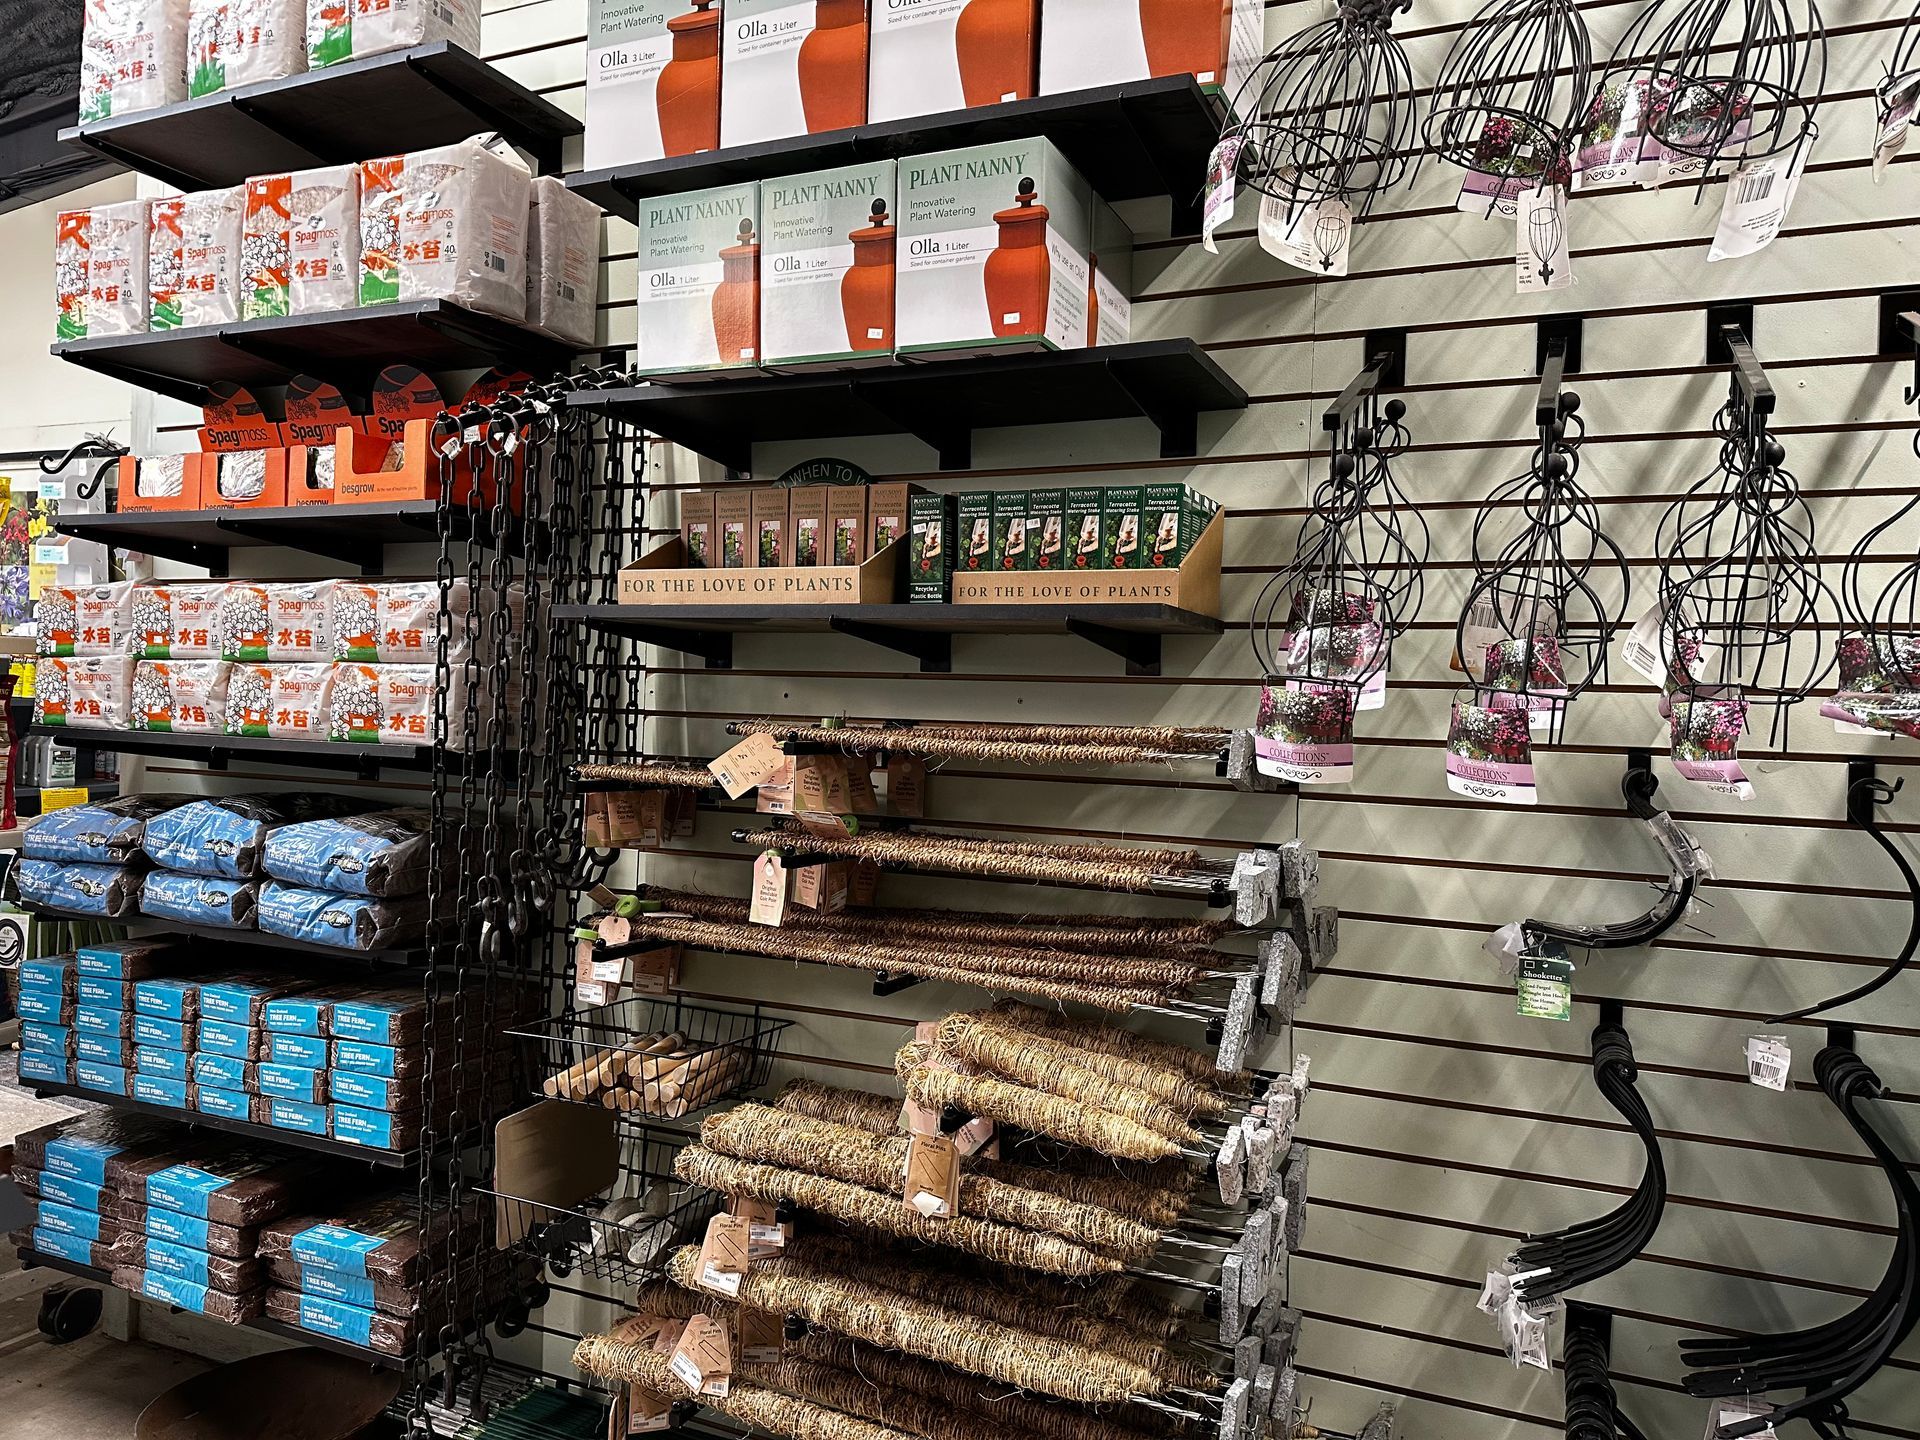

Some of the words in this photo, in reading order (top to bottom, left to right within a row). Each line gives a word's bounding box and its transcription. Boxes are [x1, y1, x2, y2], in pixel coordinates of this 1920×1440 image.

[600, 4, 645, 20] Innovative
[600, 22, 622, 34] Plant
[624, 13, 664, 29] Watering
[738, 21, 767, 40] Olla
[772, 22, 778, 32] 3
[779, 20, 798, 31] Liter
[600, 50, 628, 68] Olla
[632, 53, 638, 63] 3
[638, 50, 656, 62] Liter
[910, 164, 962, 190] PLANT
[966, 154, 1026, 180] NANNY
[773, 185, 821, 210] PLANT
[824, 176, 878, 200] NANNY
[910, 196, 956, 210] Innovative
[650, 205, 693, 228] PLANT
[696, 197, 746, 218] NANNY
[910, 211, 932, 222] Plant
[934, 206, 976, 218] Watering
[774, 215, 814, 229] Innovative
[650, 234, 688, 246] Innovative
[774, 228, 794, 241] Plant
[796, 225, 833, 238] Watering
[403, 239, 442, 261] 水苔
[650, 246, 668, 258] Plant
[670, 242, 704, 256] Watering
[910, 239, 940, 256] Olla
[952, 241, 970, 250] Liter
[294, 258, 328, 278] 水苔
[774, 256, 801, 272] Olla
[811, 258, 828, 268] Liter
[932, 258, 954, 266] container
[186, 274, 216, 292] 水苔
[650, 273, 676, 288] Olla
[684, 274, 700, 284] Liter
[91, 285, 120, 302] 水苔
[208, 428, 268, 446] Spagmoss
[788, 463, 831, 486] WHEN
[835, 465, 853, 482] TO
[342, 482, 374, 496] besgrow
[624, 579, 655, 593] FOR
[662, 579, 695, 592] THE
[703, 578, 745, 592] LOVE
[754, 578, 776, 592] OF
[784, 577, 853, 591] PLANTS
[958, 586, 988, 598] FOR
[994, 586, 1024, 597] THE
[1032, 586, 1072, 597] LOVE
[1080, 586, 1100, 597] OF
[1108, 586, 1172, 597] PLANTS
[278, 600, 323, 612] Spagmoss
[83, 627, 110, 644] 水苔
[178, 628, 208, 646] 水苔
[278, 628, 312, 648] 水苔
[386, 628, 424, 648] 水苔
[74, 698, 100, 715] 水苔
[180, 704, 206, 722] 水苔
[277, 708, 310, 728] 水苔
[390, 713, 426, 733] 水苔
[1523, 970, 1563, 981] Shookettes
[1759, 1055, 1774, 1063] A13
[320, 1279, 336, 1289] FERN
